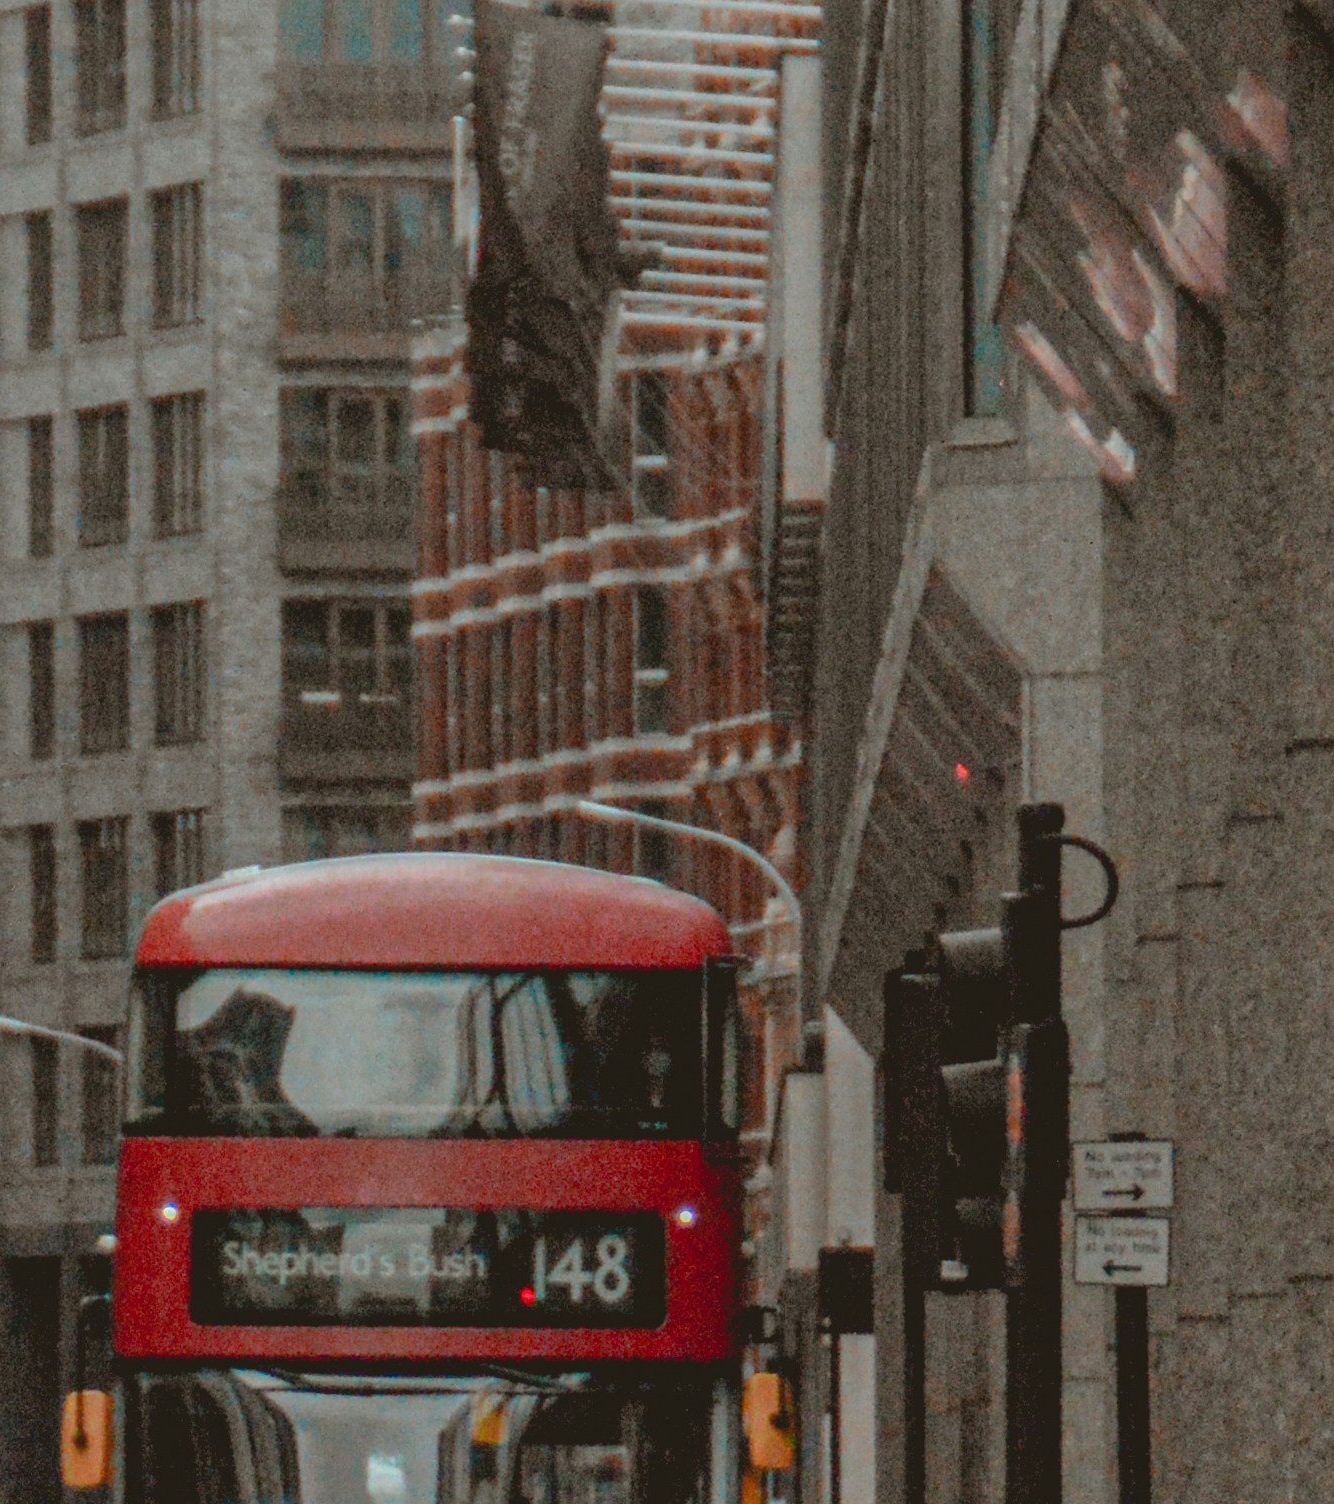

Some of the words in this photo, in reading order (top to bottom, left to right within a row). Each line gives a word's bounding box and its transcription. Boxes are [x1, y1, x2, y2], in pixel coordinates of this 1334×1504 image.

[1085, 1151, 1105, 1163] No
[1111, 1224, 1159, 1240] loading
[223, 1241, 395, 1285] Shepherd's
[409, 1243, 489, 1277] Bush
[533, 1234, 631, 1302] 148
